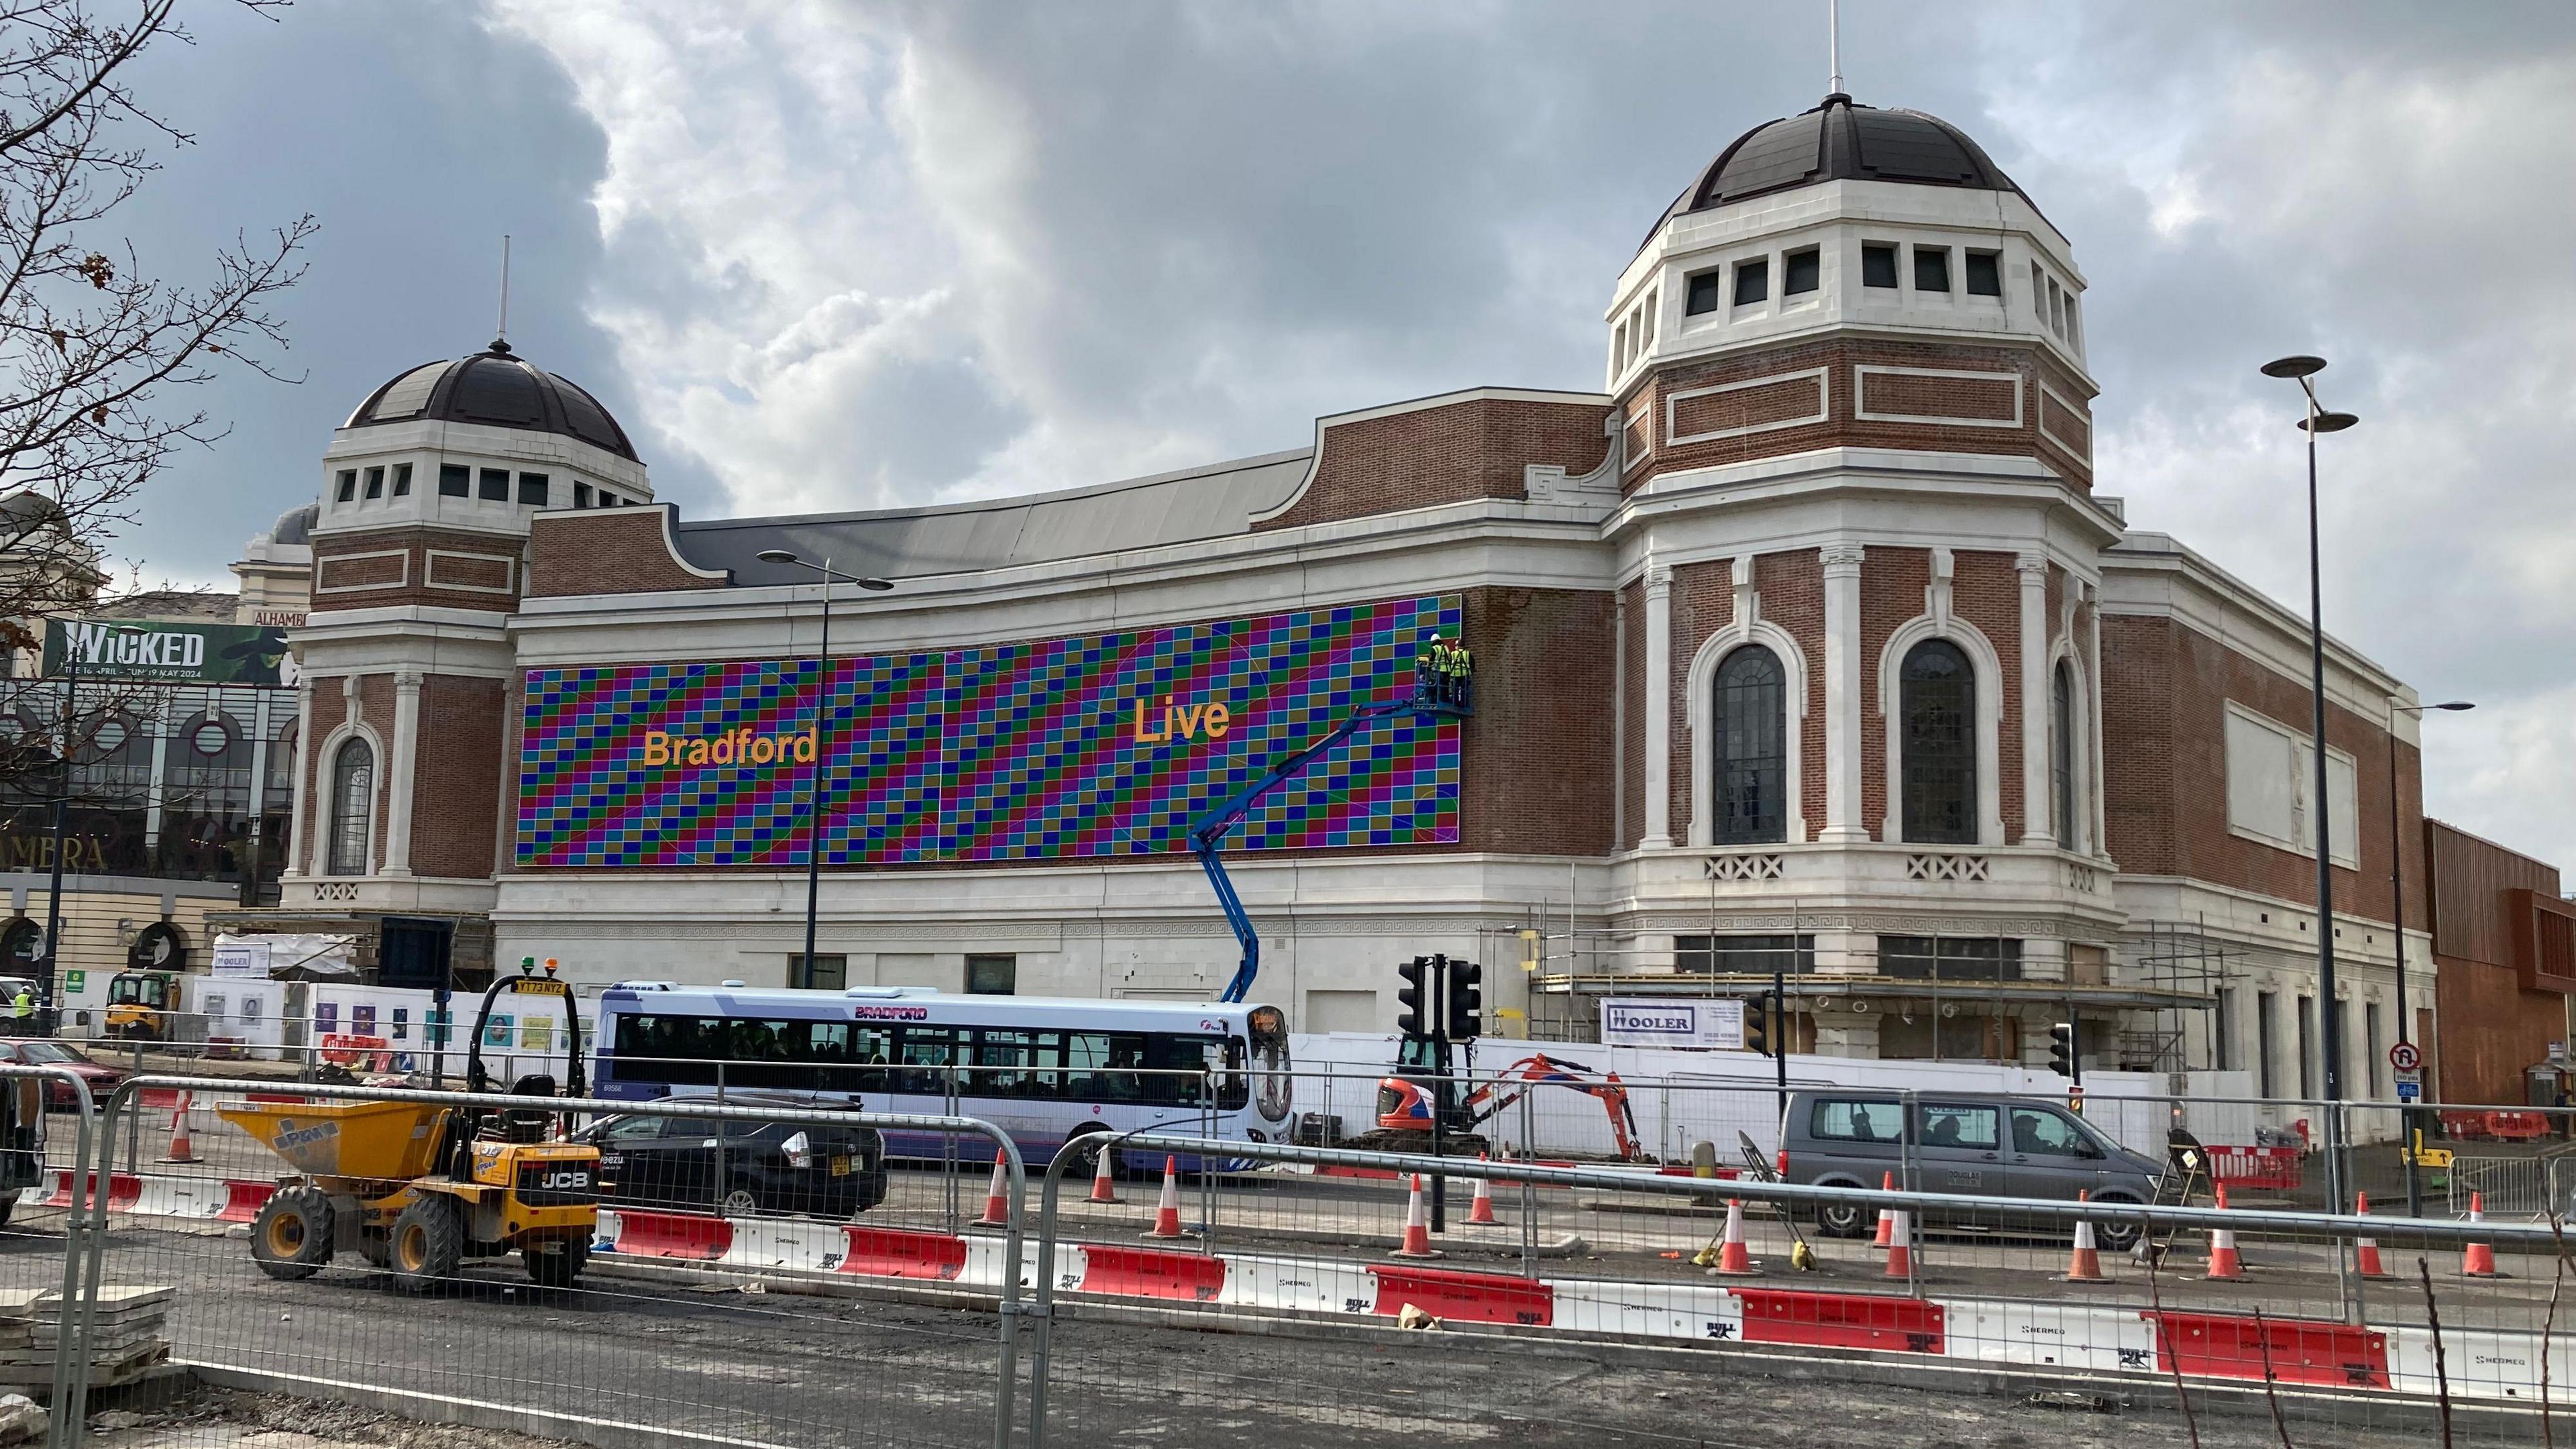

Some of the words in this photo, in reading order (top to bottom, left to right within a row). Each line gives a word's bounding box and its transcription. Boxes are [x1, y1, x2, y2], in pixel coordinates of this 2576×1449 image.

[159, 669, 178, 678] MAY
[180, 670, 201, 678] 2024
[1134, 696, 1230, 743] Live
[644, 728, 817, 765] Bradford
[519, 982, 543, 992] YT73
[545, 983, 563, 994] NYZ
[855, 1006, 927, 1020] BRADFORD
[1613, 1010, 1688, 1029] WOOLER
[541, 1173, 588, 1189] JCB
[824, 1252, 843, 1261] BULL
[1345, 1298, 1371, 1308] BULL
[1707, 1322, 1736, 1332] BULL
[2476, 1355, 2526, 1366] SHERMEQ
